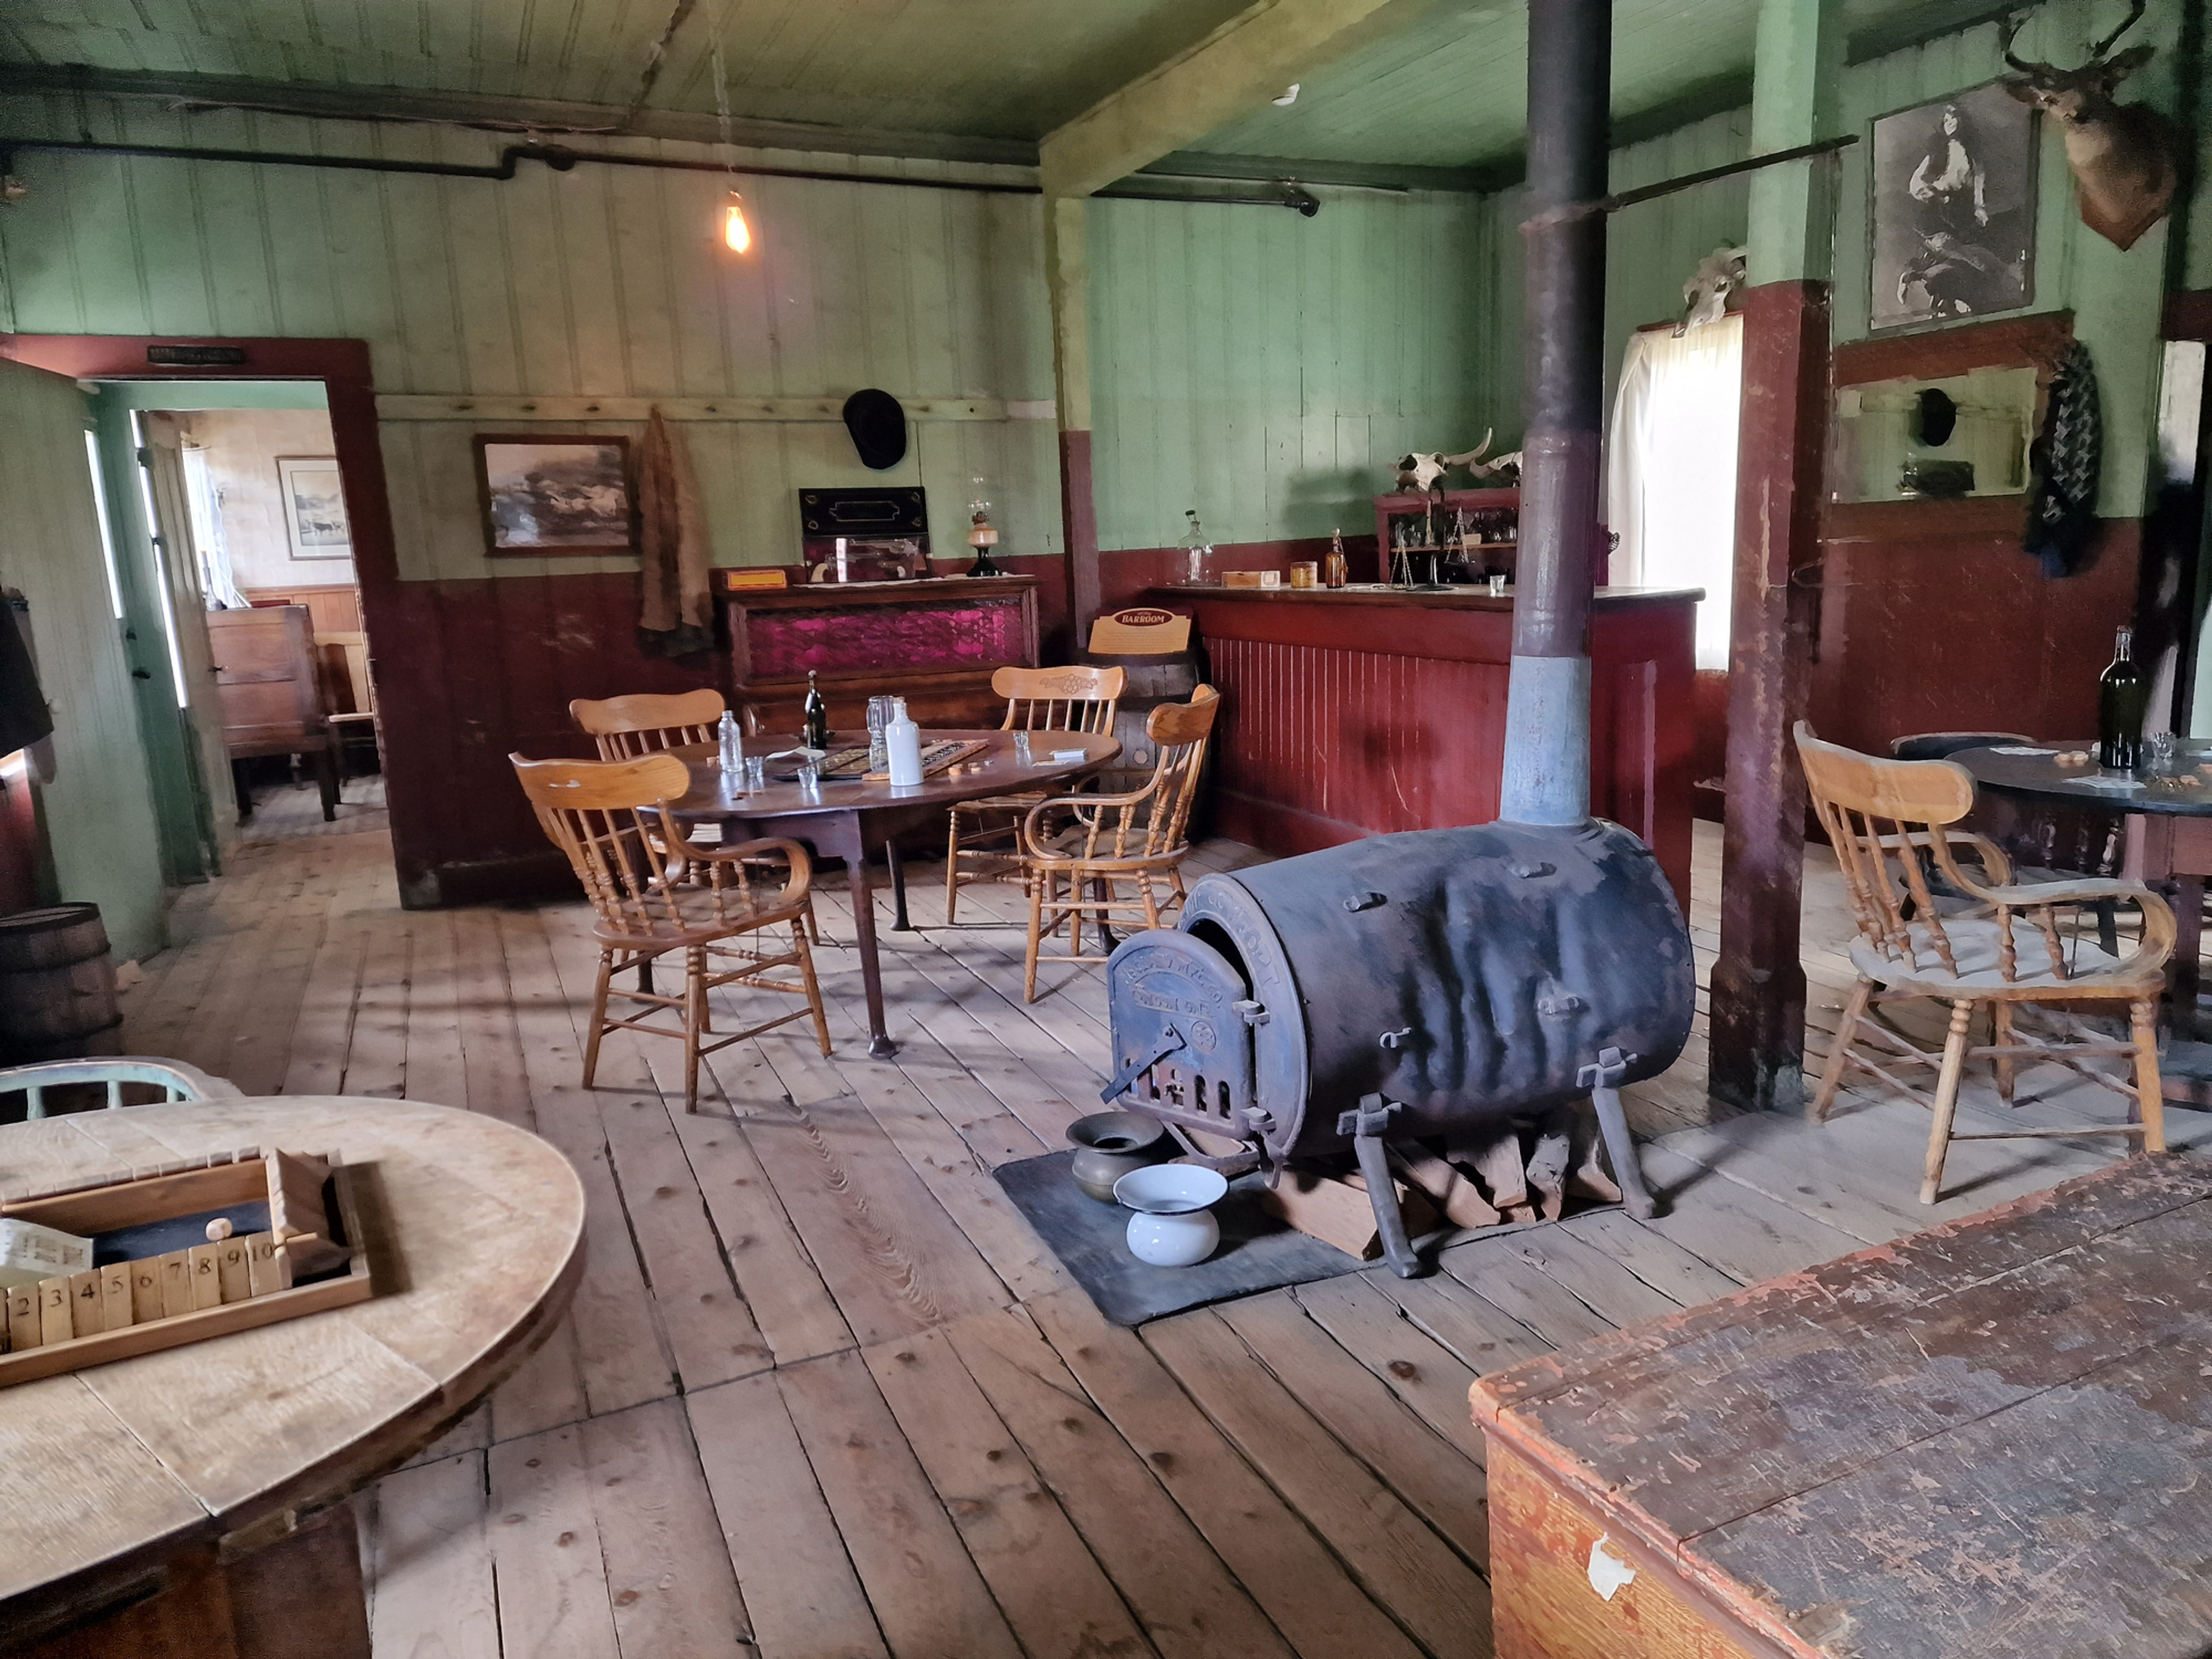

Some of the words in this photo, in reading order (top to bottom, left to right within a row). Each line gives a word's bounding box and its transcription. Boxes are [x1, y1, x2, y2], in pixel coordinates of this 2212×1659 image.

[1122, 615, 1165, 623] BARROOM
[17, 1297, 30, 1316] 2
[50, 1290, 62, 1307] 3
[80, 1283, 95, 1299] 4
[111, 1275, 124, 1293] 5
[139, 1275, 152, 1288] 6
[169, 1261, 181, 1278] 7
[197, 1258, 212, 1274] 8
[227, 1250, 241, 1265] 9
[252, 1243, 274, 1263] 10
